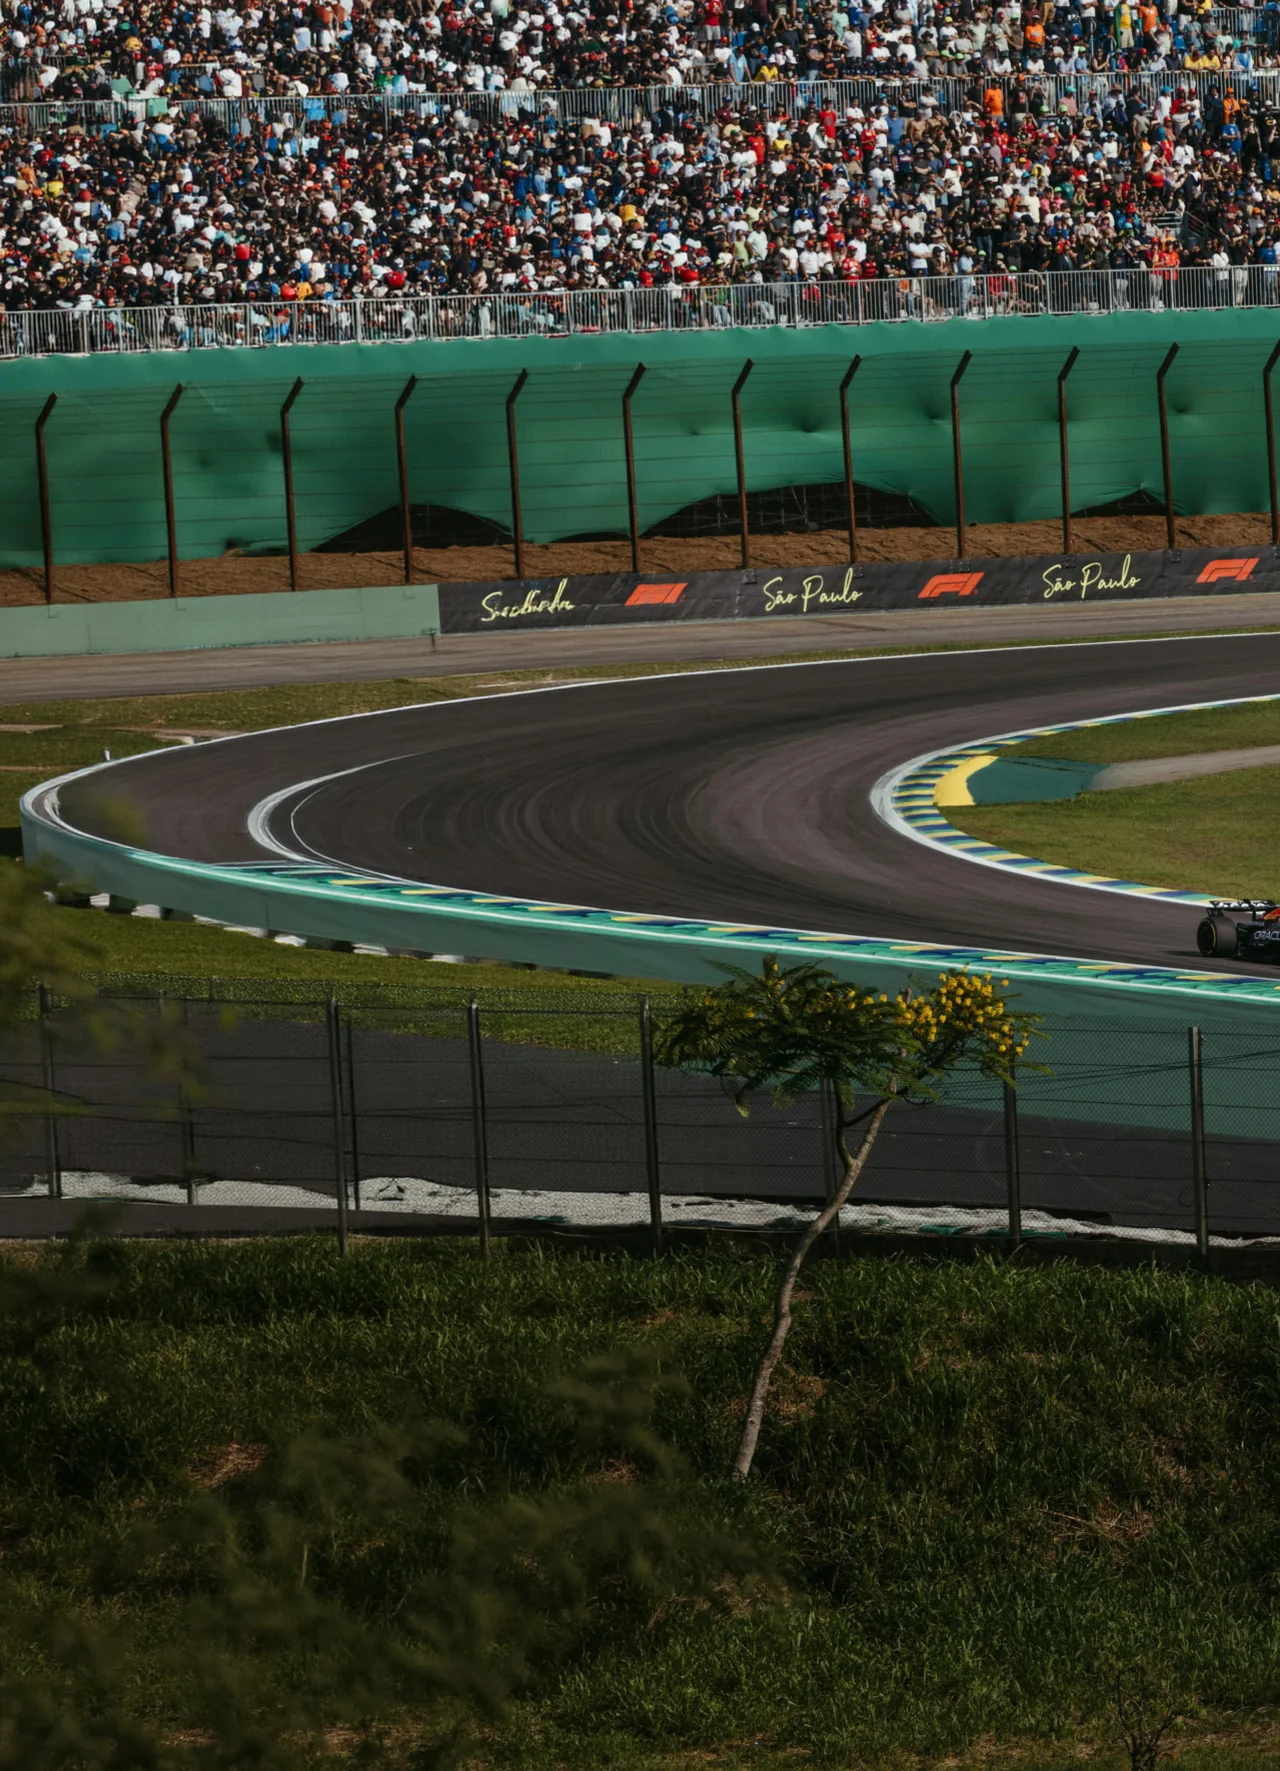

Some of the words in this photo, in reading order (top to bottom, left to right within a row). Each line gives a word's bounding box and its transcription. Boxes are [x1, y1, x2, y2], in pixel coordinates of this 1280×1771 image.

[764, 576, 798, 611] São
[801, 567, 863, 612] Paulo
[1042, 563, 1076, 599] São
[1080, 554, 1141, 599] Paulo
